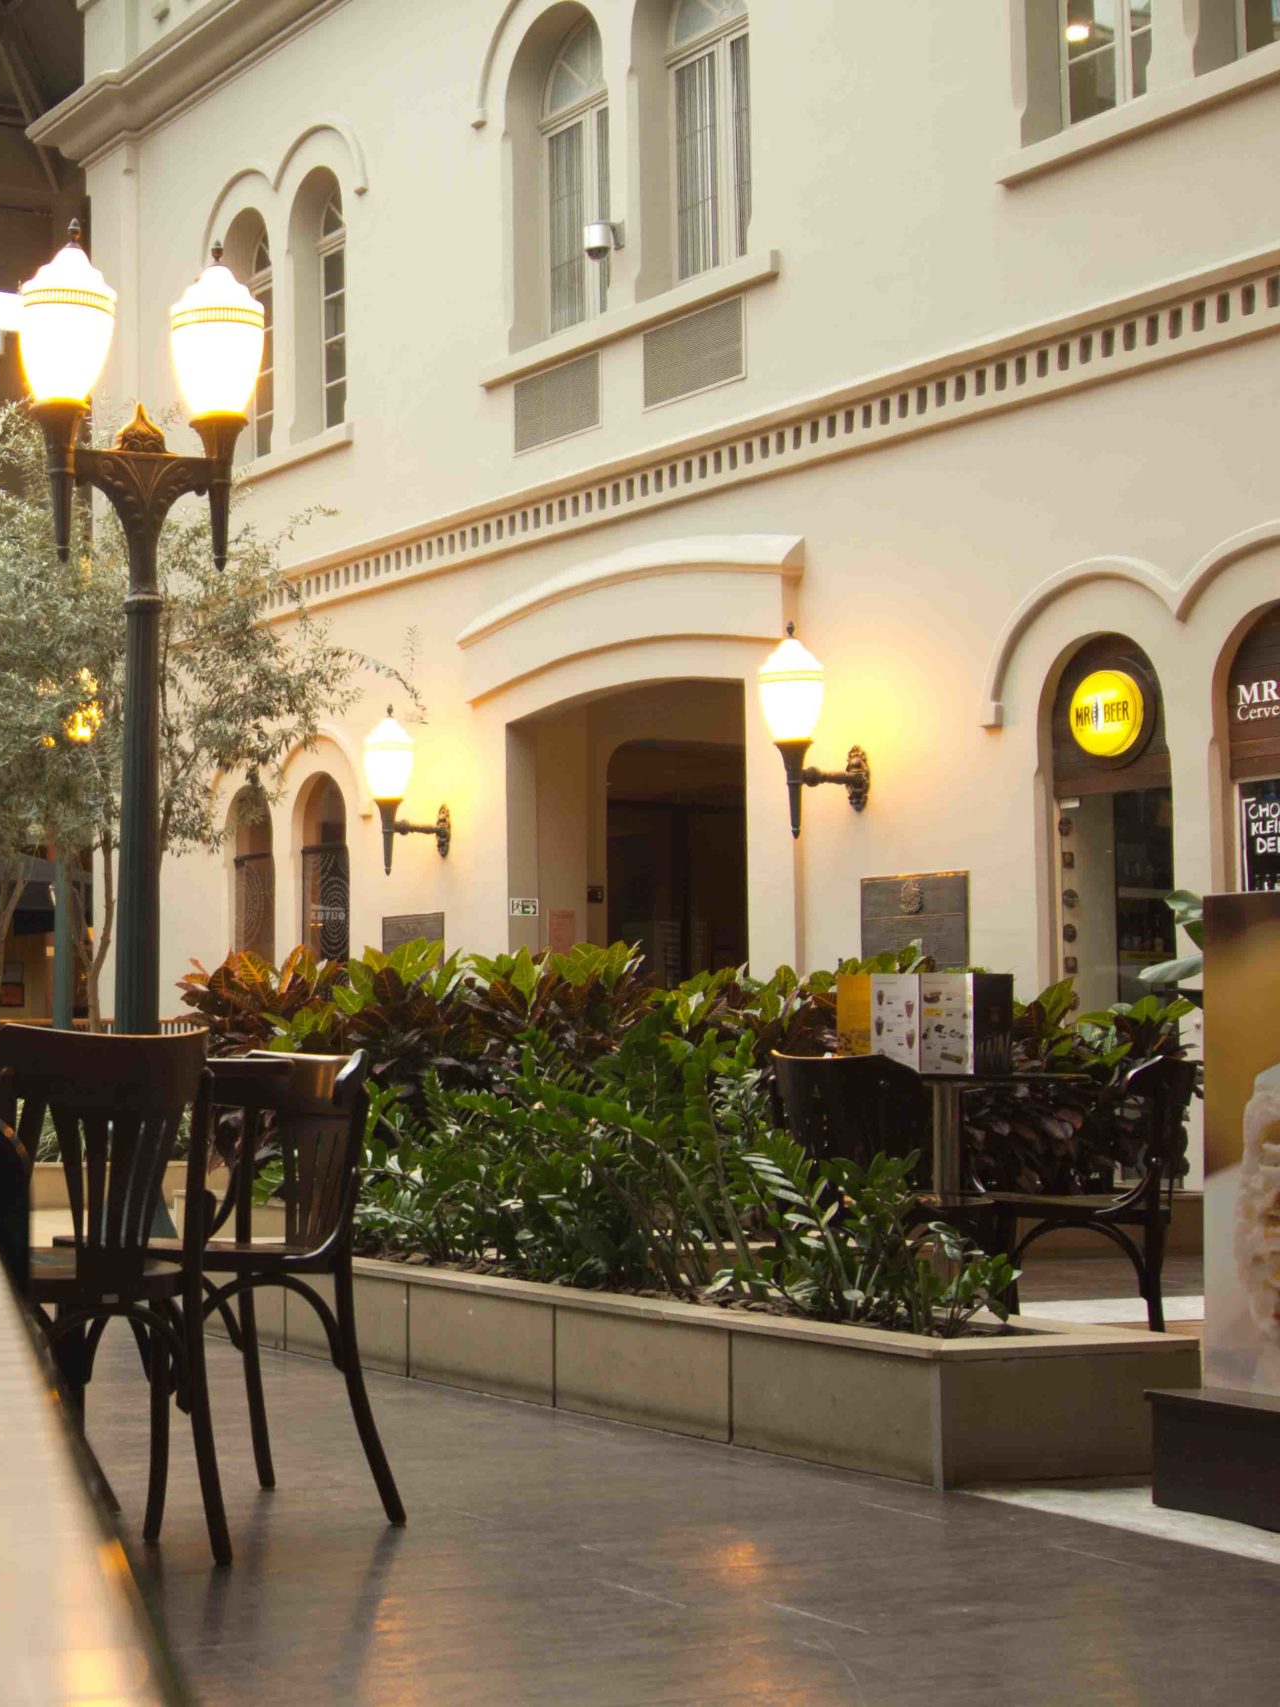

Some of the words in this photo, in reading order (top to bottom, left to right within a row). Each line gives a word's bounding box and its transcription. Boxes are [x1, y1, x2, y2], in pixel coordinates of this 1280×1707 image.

[1237, 680, 1280, 706] MR
[1075, 706, 1091, 728] MR
[1103, 700, 1130, 724] BEER
[1251, 818, 1280, 836] KLEI
[1256, 836, 1280, 854] DE
